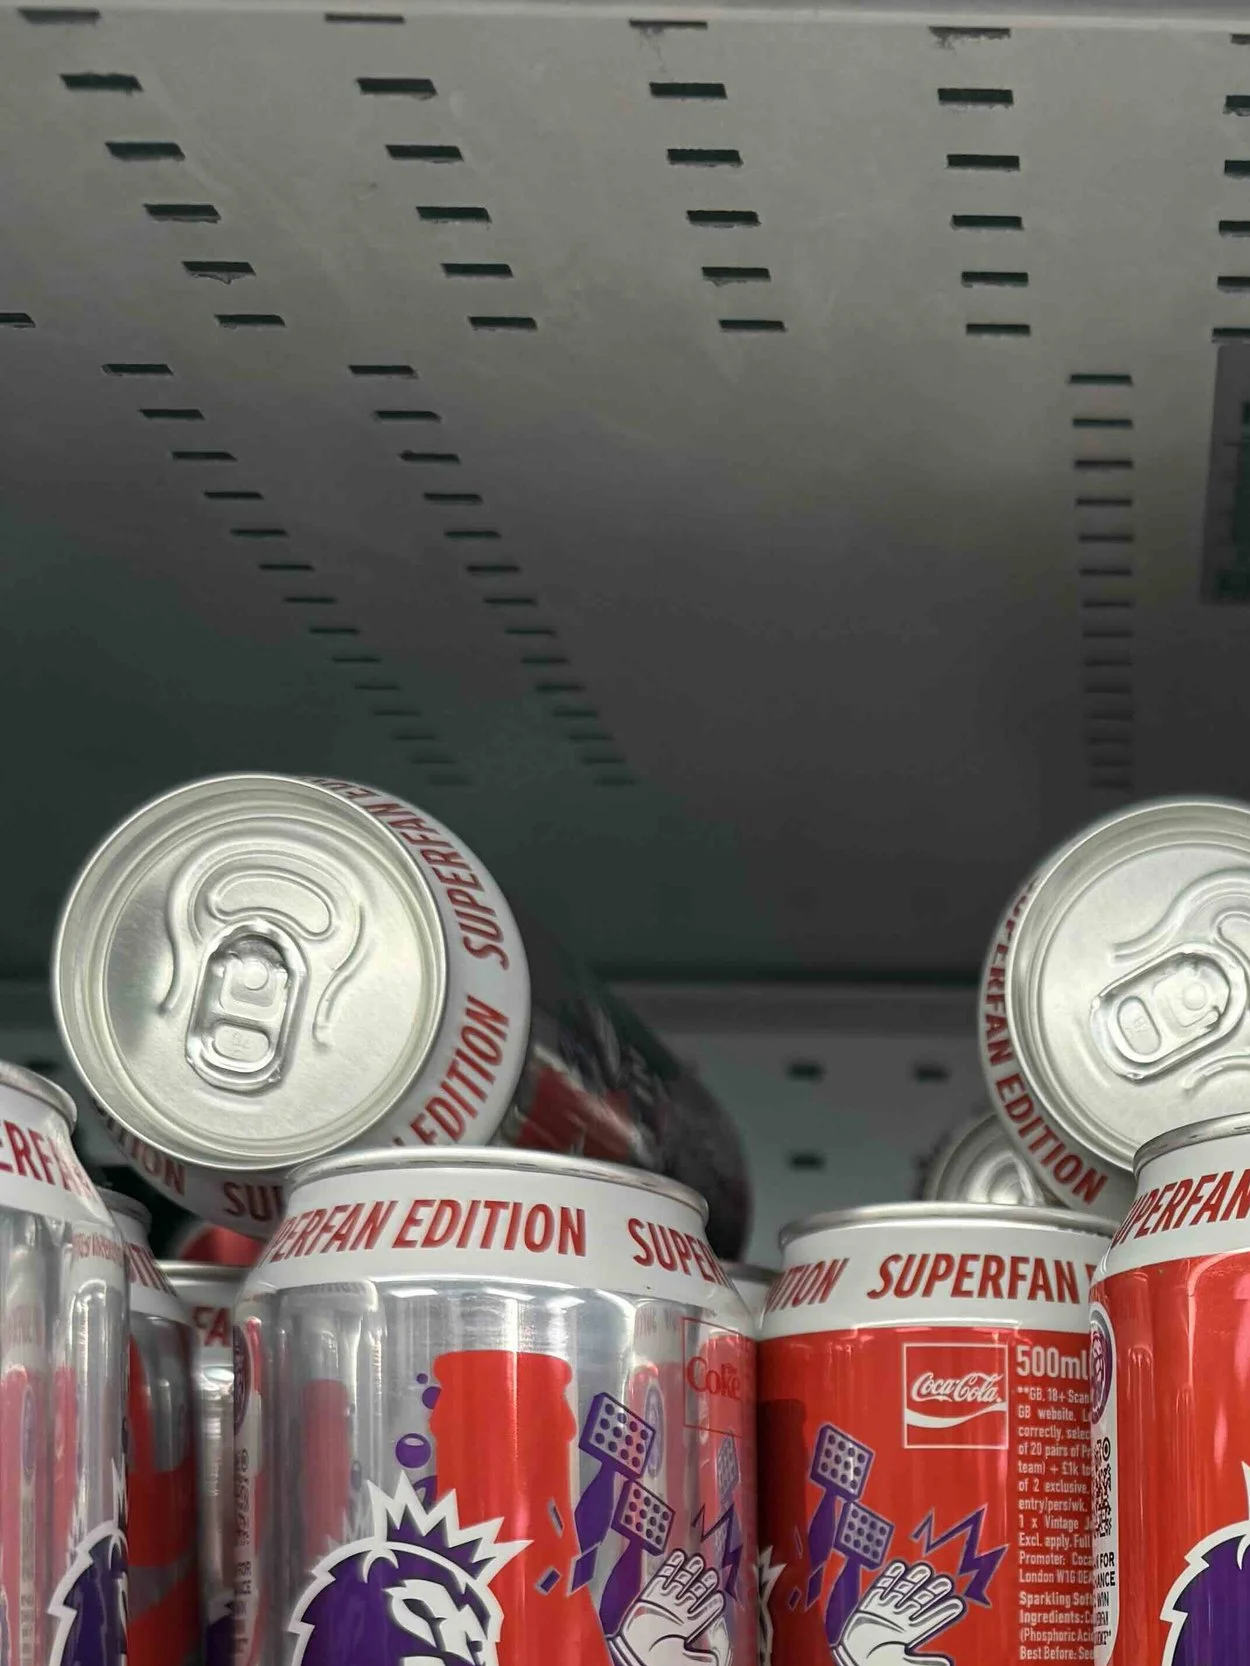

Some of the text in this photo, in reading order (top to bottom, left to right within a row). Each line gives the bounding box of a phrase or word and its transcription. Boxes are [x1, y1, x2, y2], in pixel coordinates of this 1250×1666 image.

[363, 803, 510, 970] SUPERFAN
[996, 1073, 1108, 1205] EDITION
[391, 1199, 587, 1256] EDITION
[866, 1253, 1080, 1304] SUPERFAN
[1016, 1345, 1089, 1380] 500ml
[911, 1372, 1003, 1404] Coca-Cola
[1019, 1569, 1054, 1584] London
[1019, 1591, 1071, 1607] Sparkling
[1019, 1609, 1084, 1626] Ingredients:
[1019, 1628, 1077, 1643] (Phosphoric
[1019, 1646, 1042, 1660] Best
[1044, 1646, 1078, 1660] Before:
